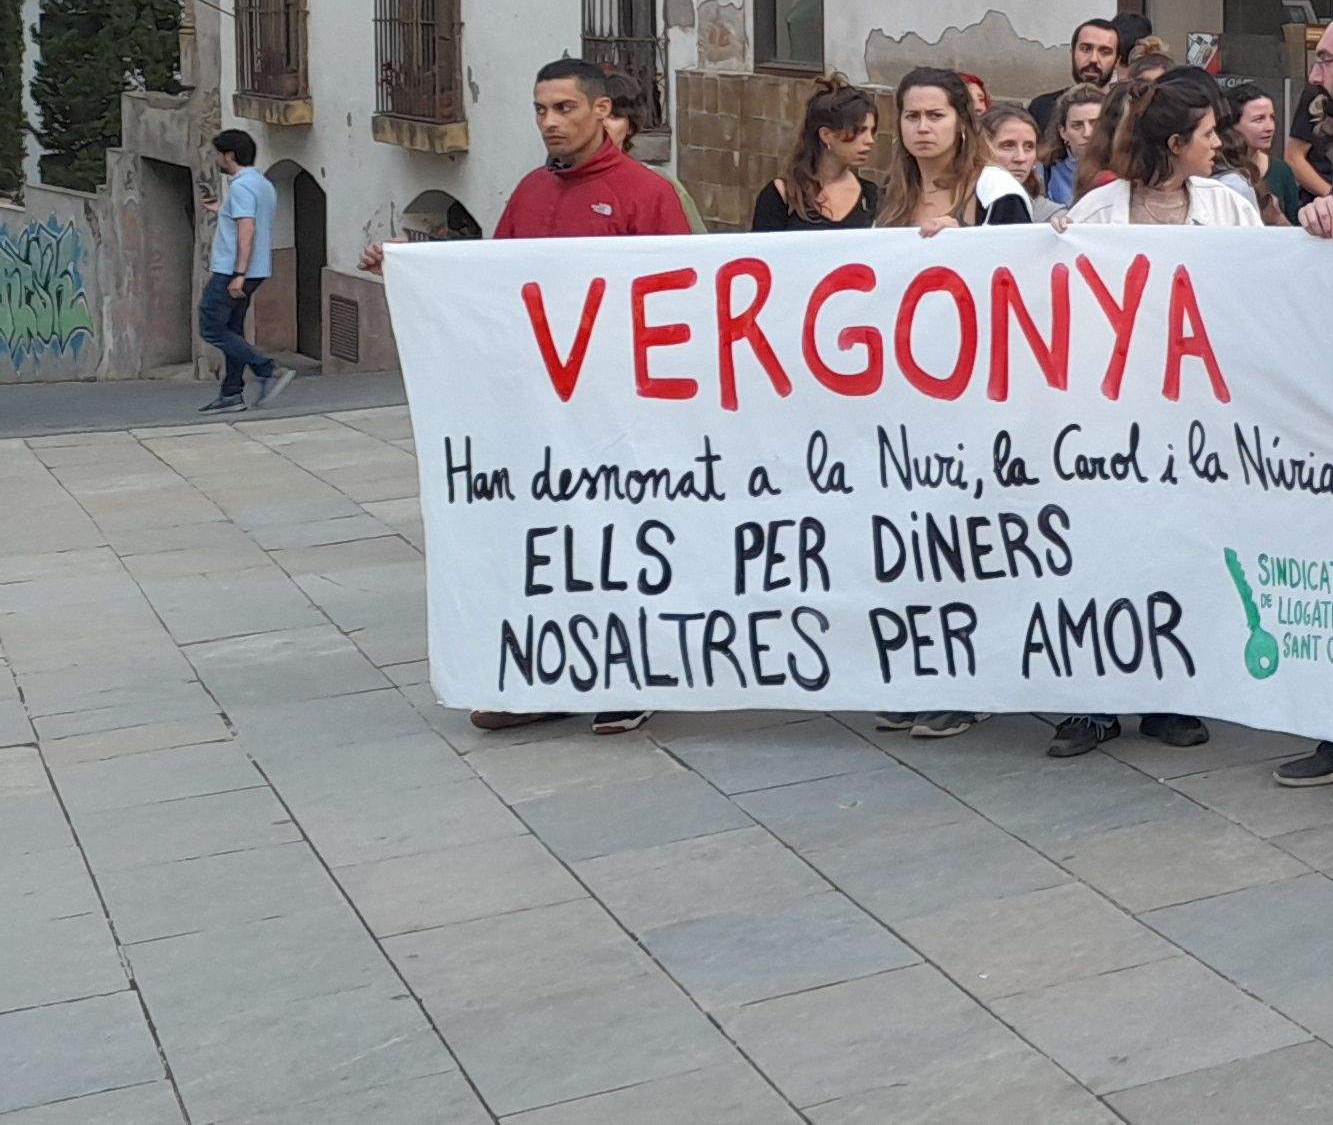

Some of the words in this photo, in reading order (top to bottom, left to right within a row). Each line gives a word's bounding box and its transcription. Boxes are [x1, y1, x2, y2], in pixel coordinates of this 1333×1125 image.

[521, 254, 1230, 412] VERGONYA
[445, 435, 516, 504] Han
[531, 434, 726, 504] desnonat
[748, 466, 782, 497] a
[806, 429, 855, 495] la
[877, 424, 984, 500] Nuri,
[991, 429, 1040, 488] la
[1053, 422, 1148, 484] Carol
[1160, 443, 1179, 485] i
[1188, 420, 1229, 482] la
[524, 519, 676, 596] ELLS
[734, 516, 831, 595] PER
[499, 606, 831, 692] NOSALTRES
[869, 601, 979, 685] PER
[1022, 591, 1197, 679] AMOR
[1260, 593, 1273, 609] DE
[1282, 632, 1323, 662] SANT
